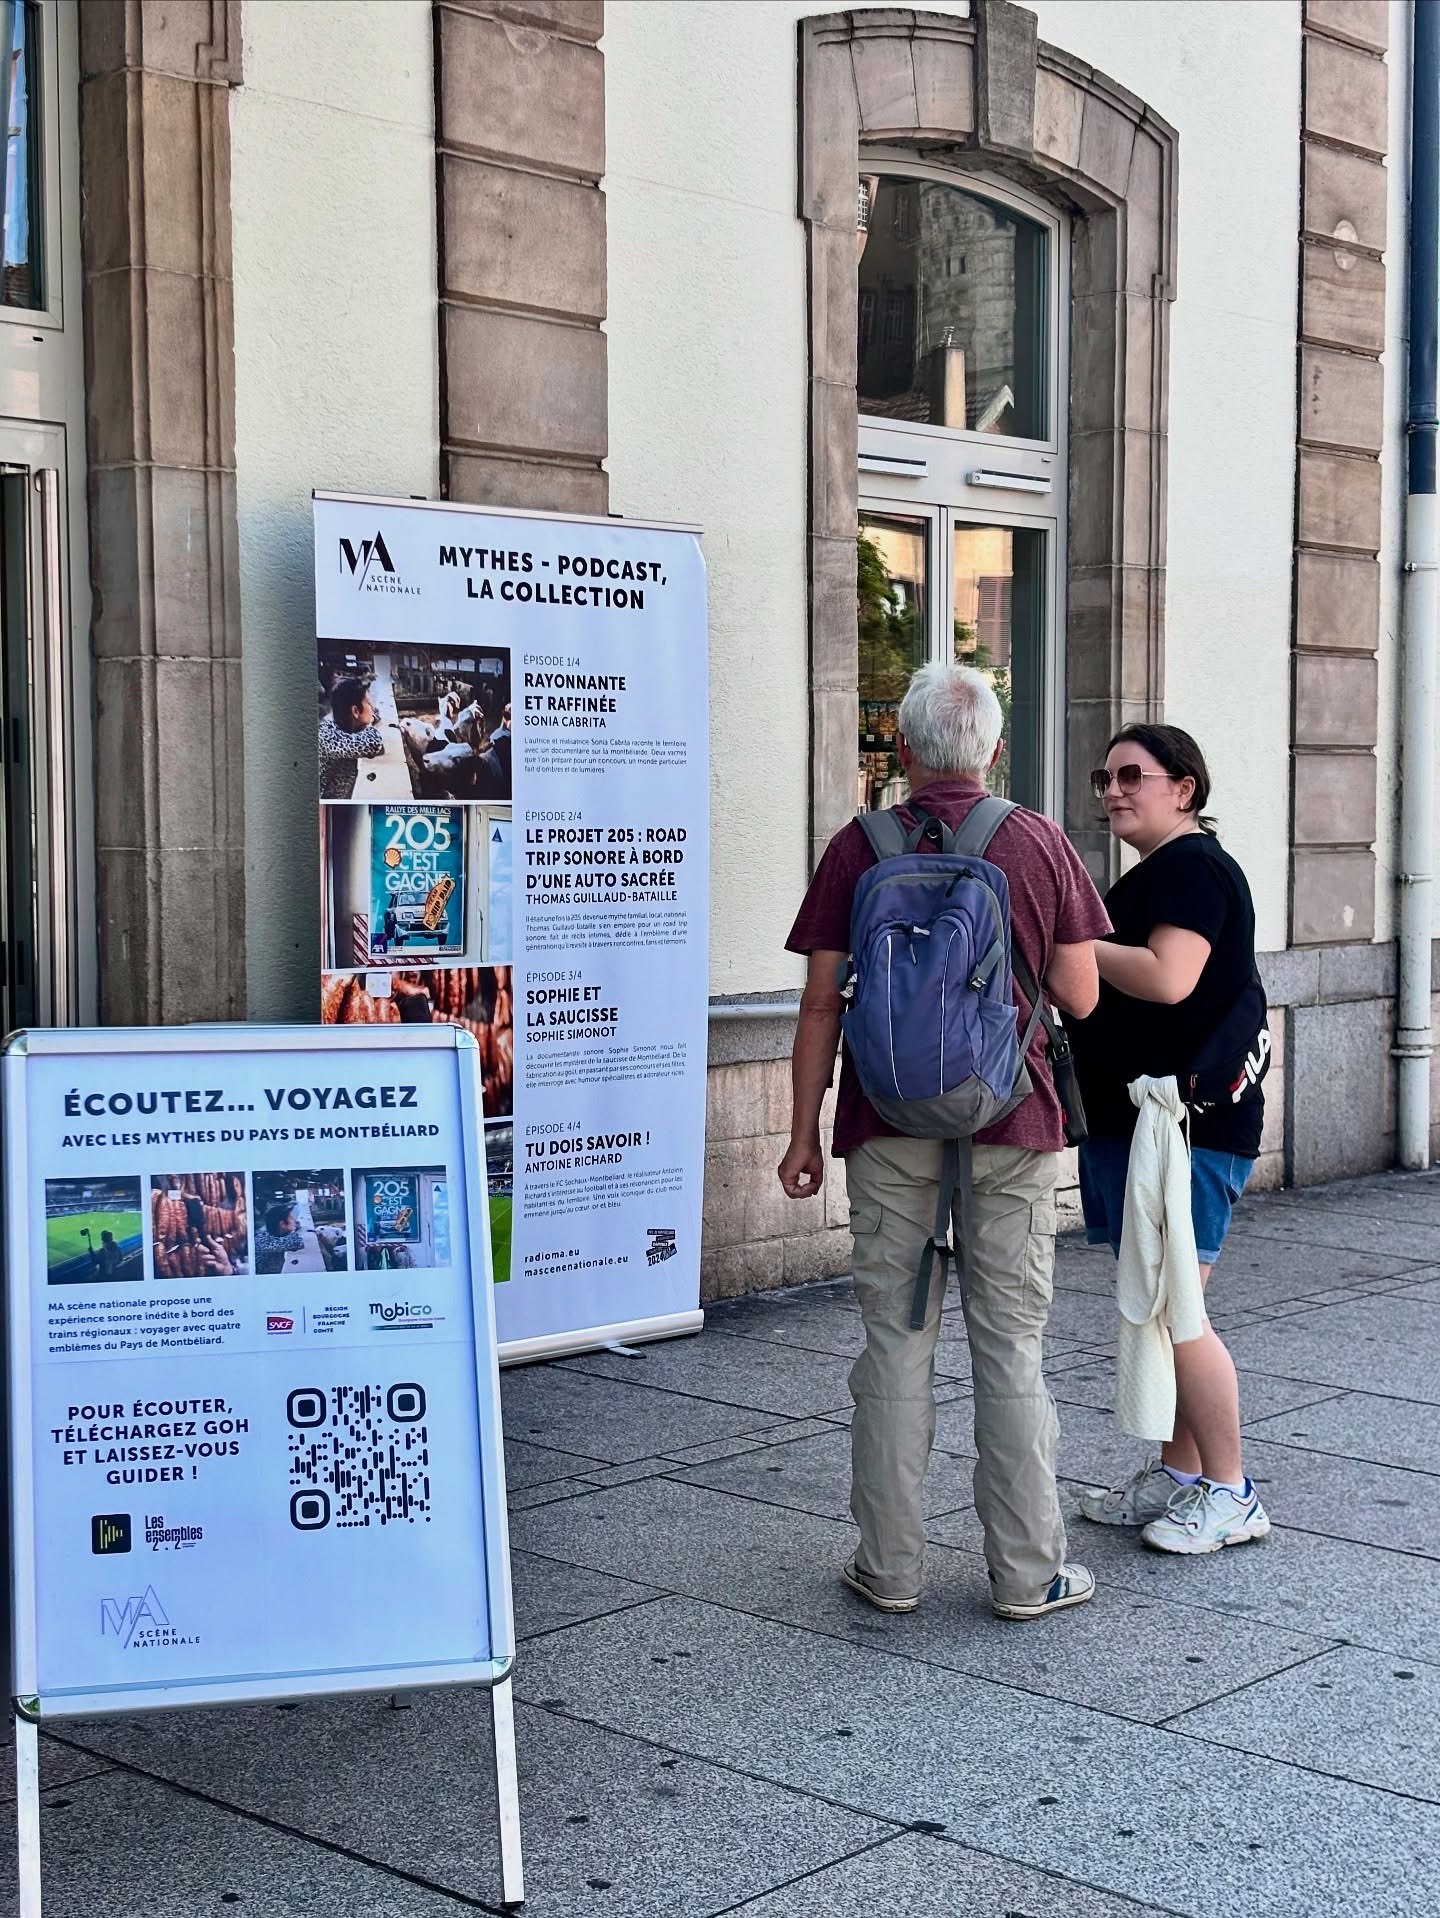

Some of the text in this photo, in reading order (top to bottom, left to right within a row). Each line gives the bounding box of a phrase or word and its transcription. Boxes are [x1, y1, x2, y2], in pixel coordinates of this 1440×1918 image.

[339, 530, 396, 591] MA
[439, 545, 534, 573] MYTHES
[558, 554, 668, 585] PODCAST,
[371, 575, 402, 585] SCÈNE
[366, 584, 421, 595] NATIONALE
[466, 577, 645, 610] LA COLLECTION
[523, 653, 580, 667] ÉPISODE 1/4
[524, 672, 626, 691] RAYONNANTE
[524, 694, 617, 713] ET RAFFINÉE
[524, 715, 606, 728] SONIA CABRITA
[591, 738, 608, 746] Sonia
[385, 805, 406, 814] RALLYE
[407, 806, 418, 814] DES
[525, 810, 582, 821] ÉPISODE 2/4
[384, 815, 451, 851] 205
[526, 828, 544, 844] LE
[548, 828, 603, 843] PROJET
[607, 828, 634, 843] 205
[646, 828, 687, 842] ROAD
[400, 853, 440, 871] C'EST
[525, 847, 684, 866] TRIP SONORE À BORD
[526, 869, 675, 889] D'UNE AUTO SACRÉE
[526, 890, 677, 905] THOMAS GUILLAUD-BATAILLE
[526, 970, 582, 983] ÉPISODE 3/4
[526, 986, 601, 1005] SOPHIE ET
[526, 1007, 618, 1027] LA SAUCISSE
[526, 1026, 617, 1043] SOPHIE SIMONOT
[603, 1055, 627, 1063] saucisse
[1229, 1028, 1271, 1103] FILA
[64, 1085, 418, 1117] ÉCOUTEZ... VOYAGEZ
[61, 1122, 440, 1148] AVEC LES MYTHES DU PAYS DE MONTBÉLIARD
[525, 1120, 581, 1136] ÉPISODE 4/4
[525, 1131, 650, 1157] TU DOIS SAVOIR !
[524, 1153, 622, 1174] ANTOINE RICHARD
[373, 1181, 410, 1196] 205
[524, 1190, 546, 1200] Richard
[584, 1184, 607, 1192] football
[529, 1182, 549, 1190] travers
[556, 1179, 564, 1187] FC
[373, 1205, 407, 1215] GAGN
[524, 1248, 580, 1263] radioma.eu
[524, 1255, 628, 1277] mascenenationale.eu
[48, 1296, 212, 1311] MA scène nationale propose une
[48, 1309, 235, 1326] expérience sonore inédite à bord des
[268, 1321, 291, 1330] SNCF
[48, 1330, 78, 1339] trains
[80, 1327, 131, 1338] régionaux
[140, 1324, 180, 1335] voyager
[183, 1323, 206, 1332] avec
[208, 1322, 241, 1332] quatre
[48, 1336, 225, 1353] emblèmes du Pays de Montbéliard.
[67, 1399, 233, 1420] POUR ÉCOUTER,
[51, 1418, 249, 1443] TÉLÉCHARGEZ GOH
[63, 1441, 240, 1465] ET LAISSEZ-VOUS
[106, 1466, 197, 1485] GUIDER !
[144, 1515, 164, 1529] Les
[145, 1525, 203, 1544] ensembles
[101, 1584, 170, 1649] MA
[139, 1627, 177, 1639] SCÈNE
[133, 1636, 200, 1648] NATIONALE
